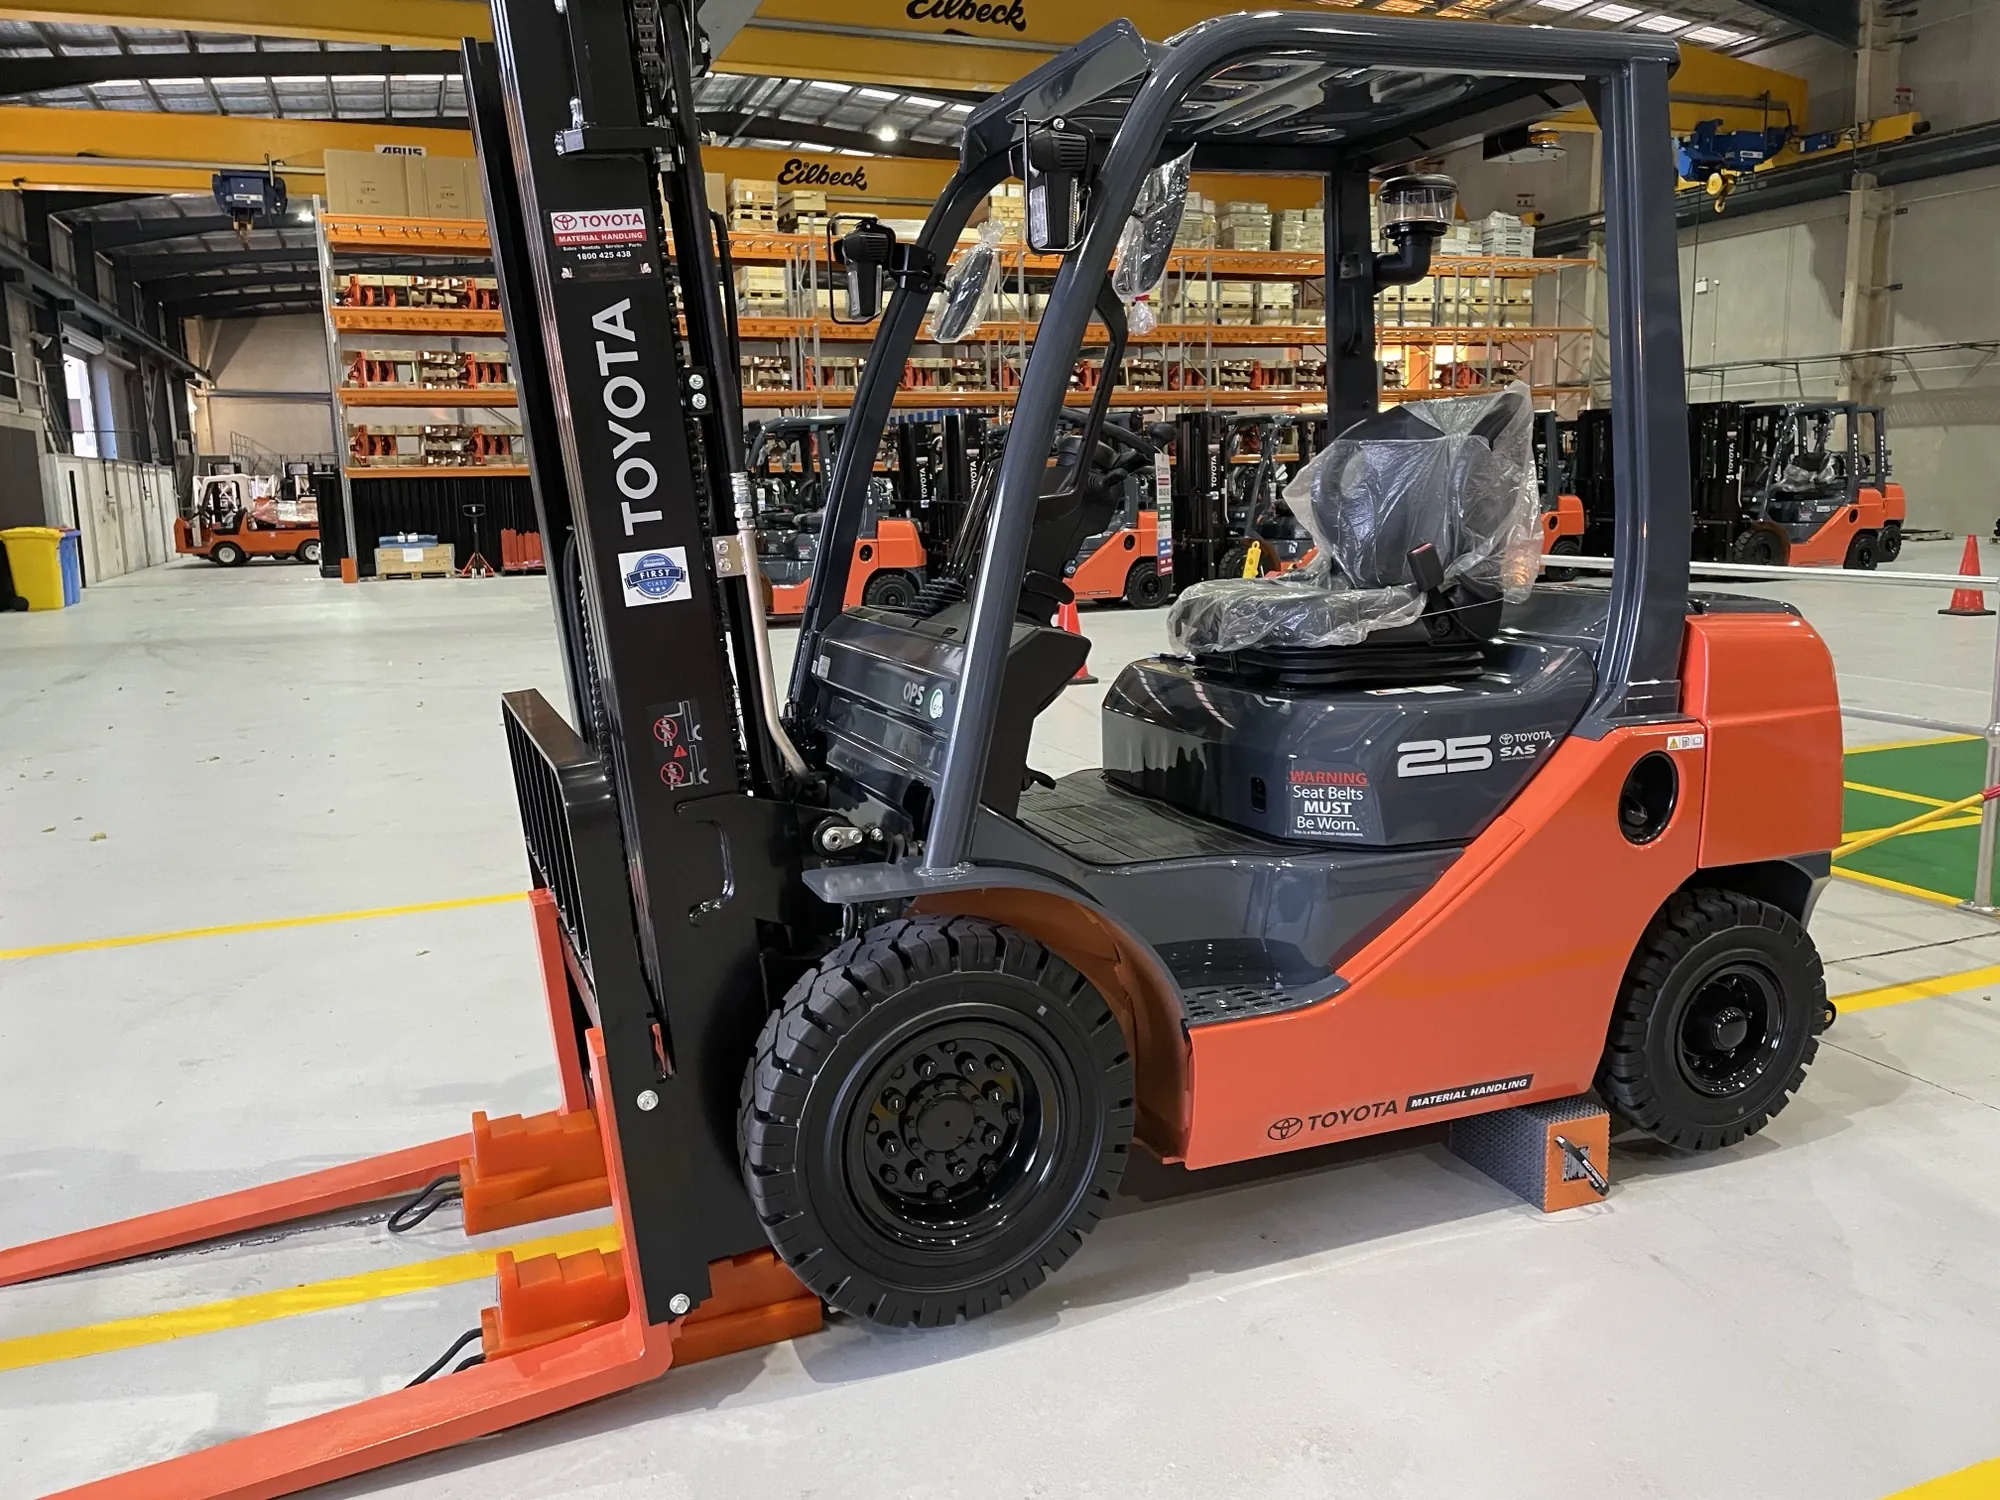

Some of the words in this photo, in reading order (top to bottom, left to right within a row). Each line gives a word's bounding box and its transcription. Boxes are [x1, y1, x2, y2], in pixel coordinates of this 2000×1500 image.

[777, 158, 868, 191] Eilbeck
[579, 214, 643, 227] TOYOTA
[558, 234, 600, 243] MATERIAL
[601, 231, 643, 241] HANDLING
[576, 252, 597, 260] 1800
[599, 251, 615, 259] 425
[616, 250, 632, 258] 438
[592, 298, 663, 536] TOYOTA
[920, 467, 928, 499] TOYOTA
[640, 569, 670, 580] FIRST
[647, 579, 667, 587] CLASS
[903, 681, 925, 705] OPS
[1514, 730, 1552, 743] TOYOTA
[1397, 734, 1493, 778] 25
[1500, 744, 1537, 757] SAS
[1289, 770, 1368, 785] WARNING
[1293, 785, 1325, 799] Seat
[1328, 786, 1364, 800] Belts
[1304, 800, 1352, 815] MUST
[1297, 816, 1315, 829] Be
[1317, 817, 1360, 831] Worn.
[1308, 1100, 1398, 1131] TOYOTA
[1411, 1090, 1467, 1108] MATERIAL
[1470, 1078, 1528, 1097] HANDLING
